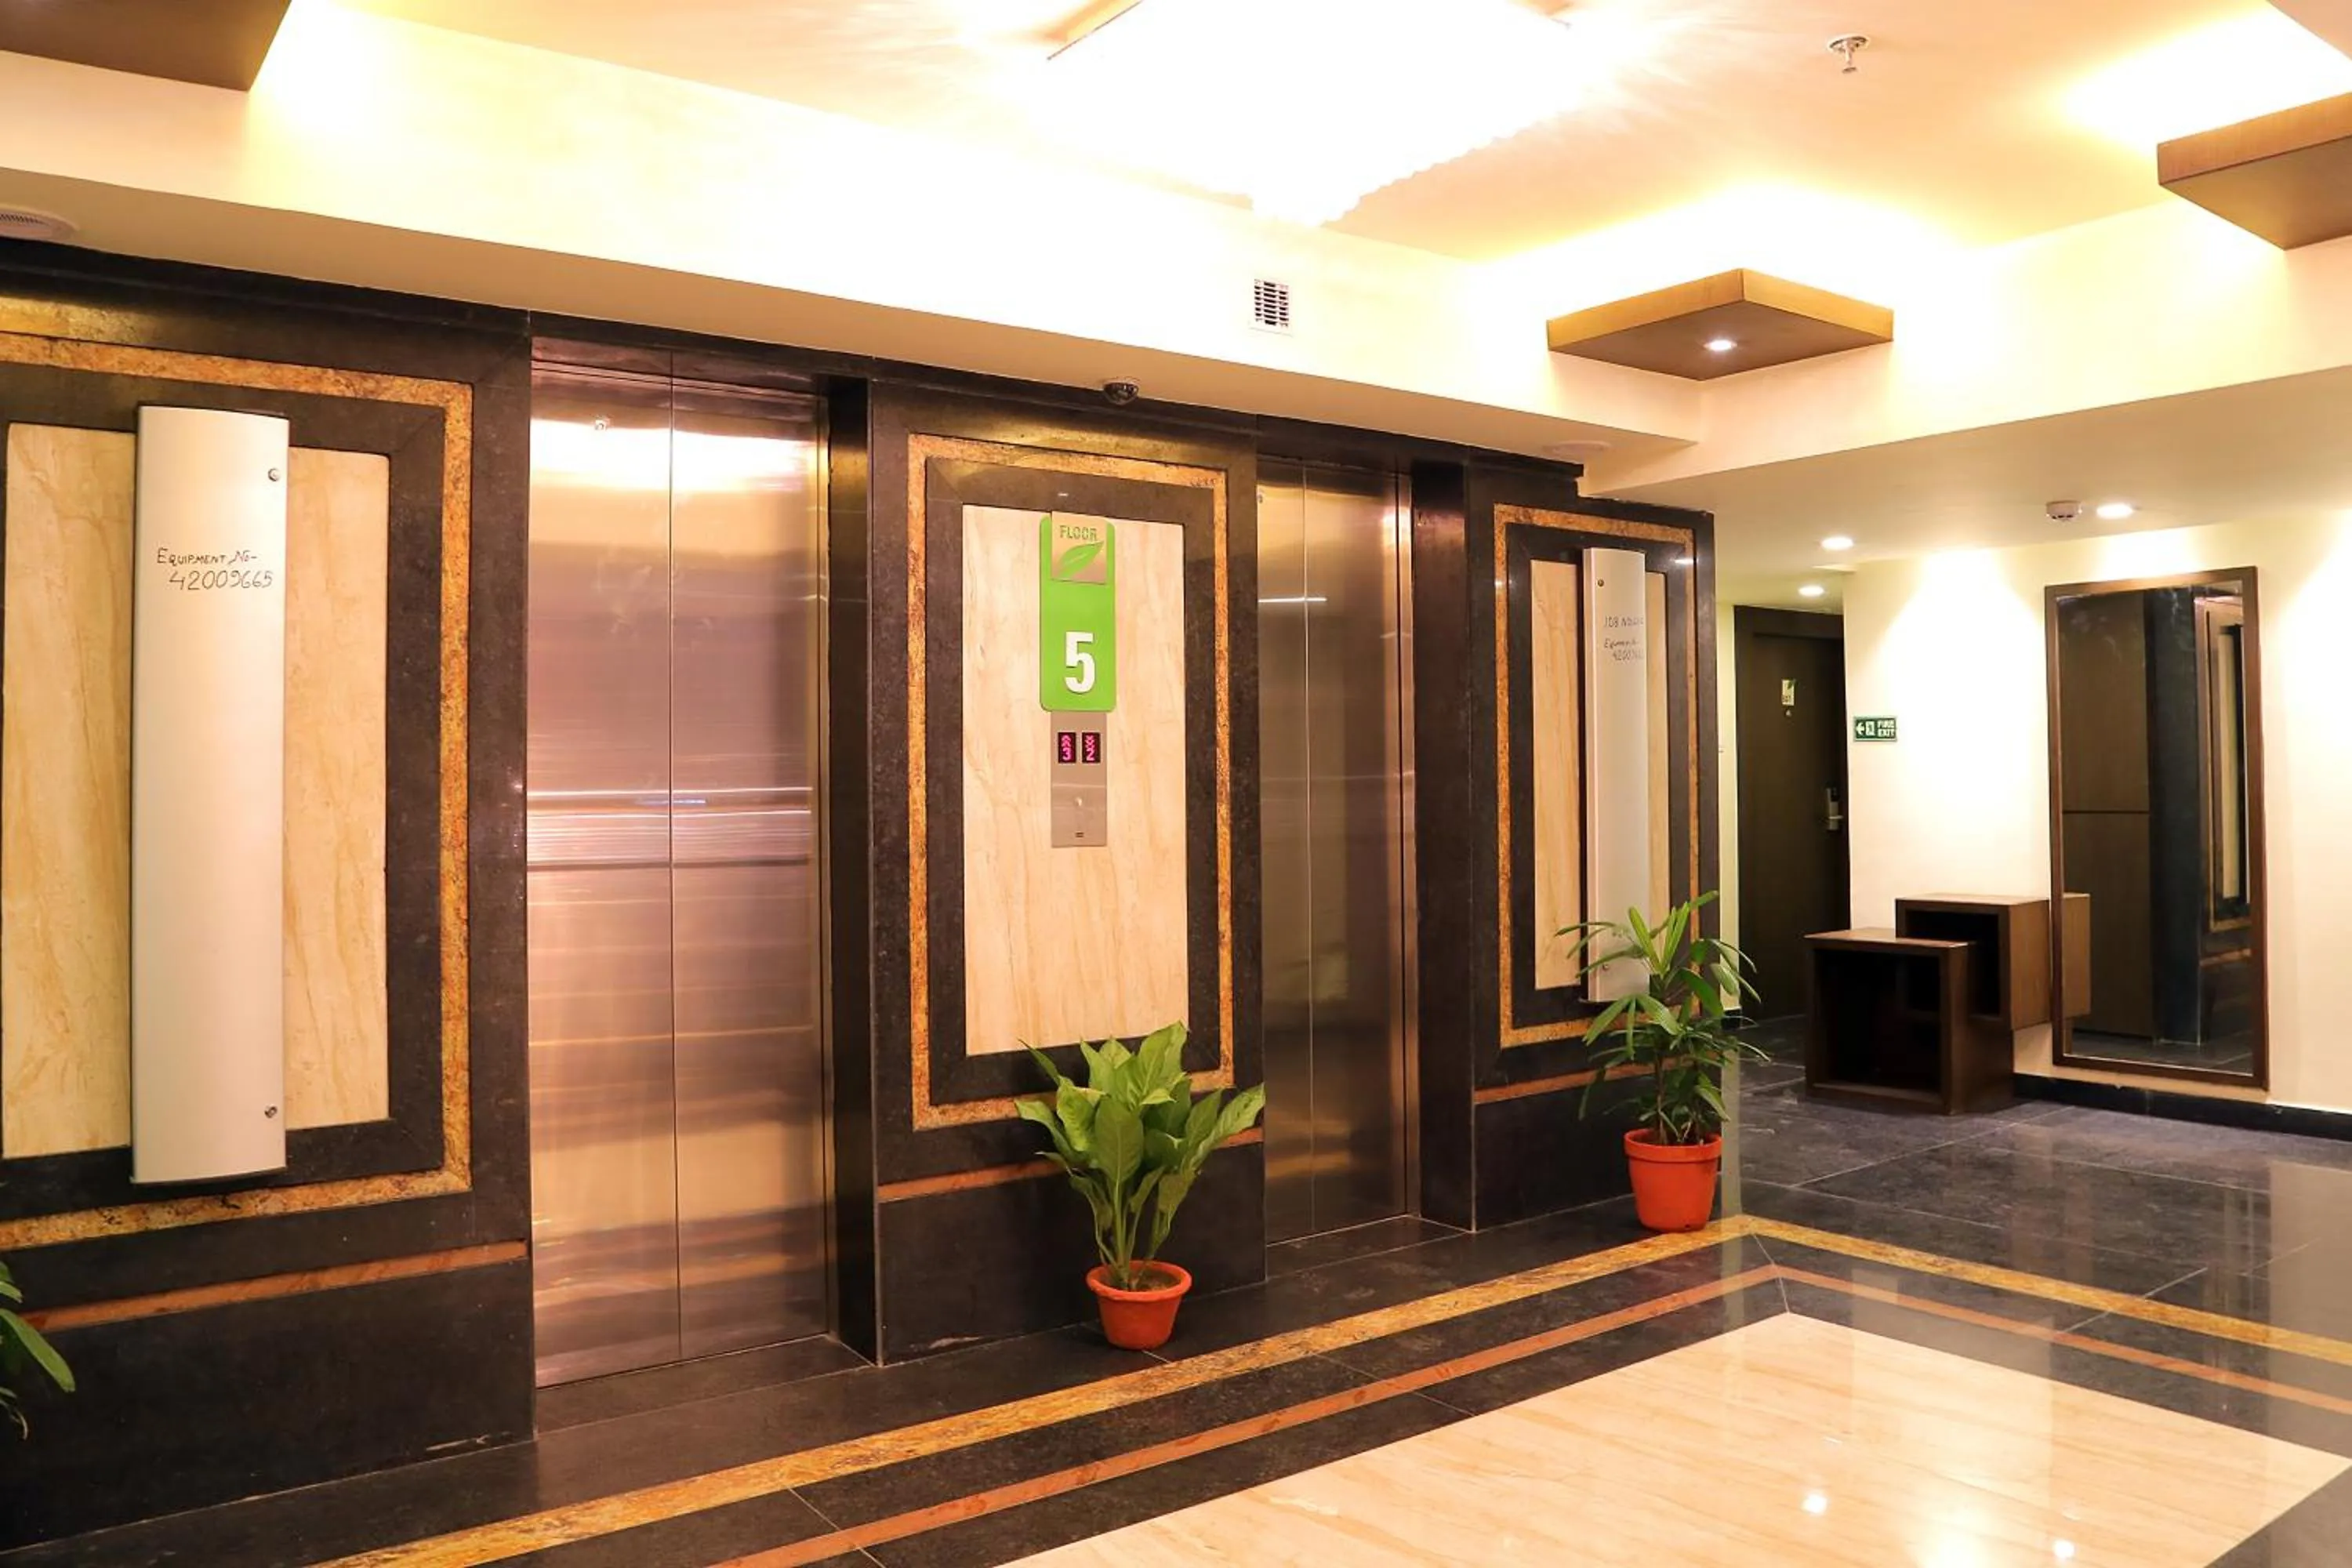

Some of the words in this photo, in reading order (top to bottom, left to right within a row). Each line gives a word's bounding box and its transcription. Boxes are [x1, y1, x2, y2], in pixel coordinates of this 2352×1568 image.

[1059, 524, 1097, 542] FLOOR
[169, 570, 273, 590] 42009665
[1064, 631, 1095, 693] 5
[1062, 746, 1073, 761] 3
[1085, 747, 1095, 761] 2
